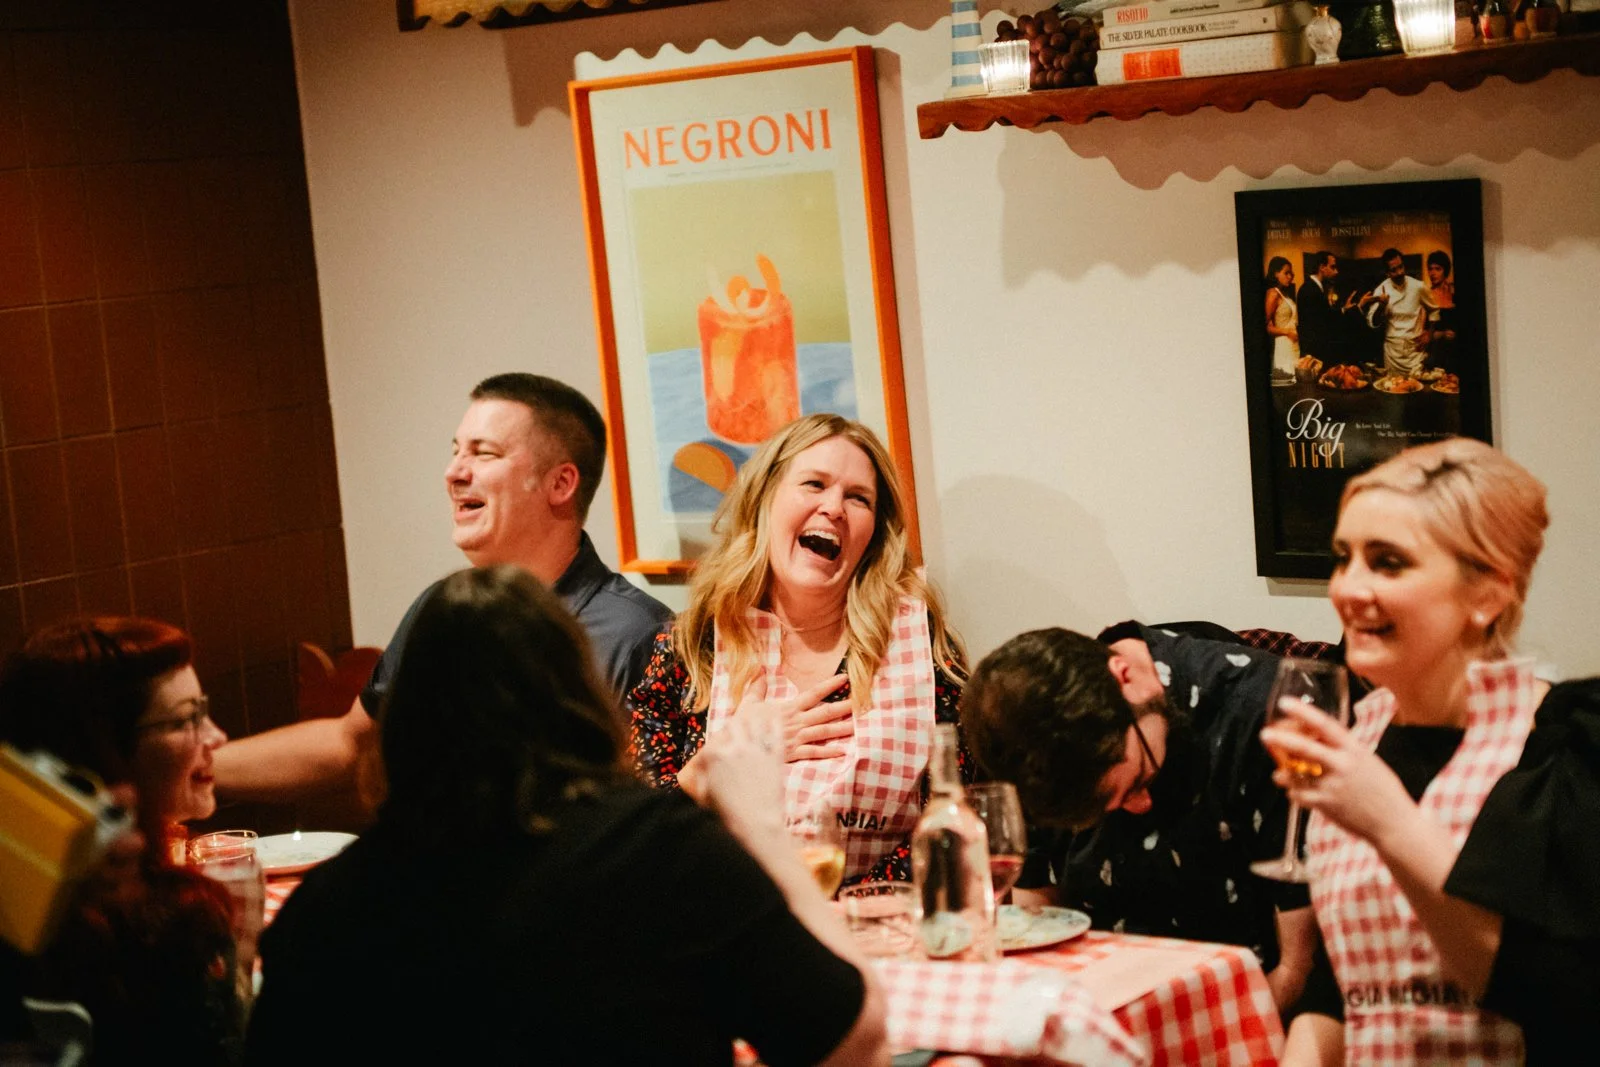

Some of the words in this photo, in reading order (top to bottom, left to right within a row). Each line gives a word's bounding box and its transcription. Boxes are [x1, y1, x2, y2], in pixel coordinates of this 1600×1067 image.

[1107, 33, 1121, 43] THE
[1122, 30, 1143, 41] SILVER
[1144, 27, 1168, 39] PALATE
[1169, 23, 1208, 36] COOKBOOK
[623, 108, 832, 169] NEGRONI
[1285, 398, 1347, 457] Big
[1288, 441, 1345, 469] NIGHT
